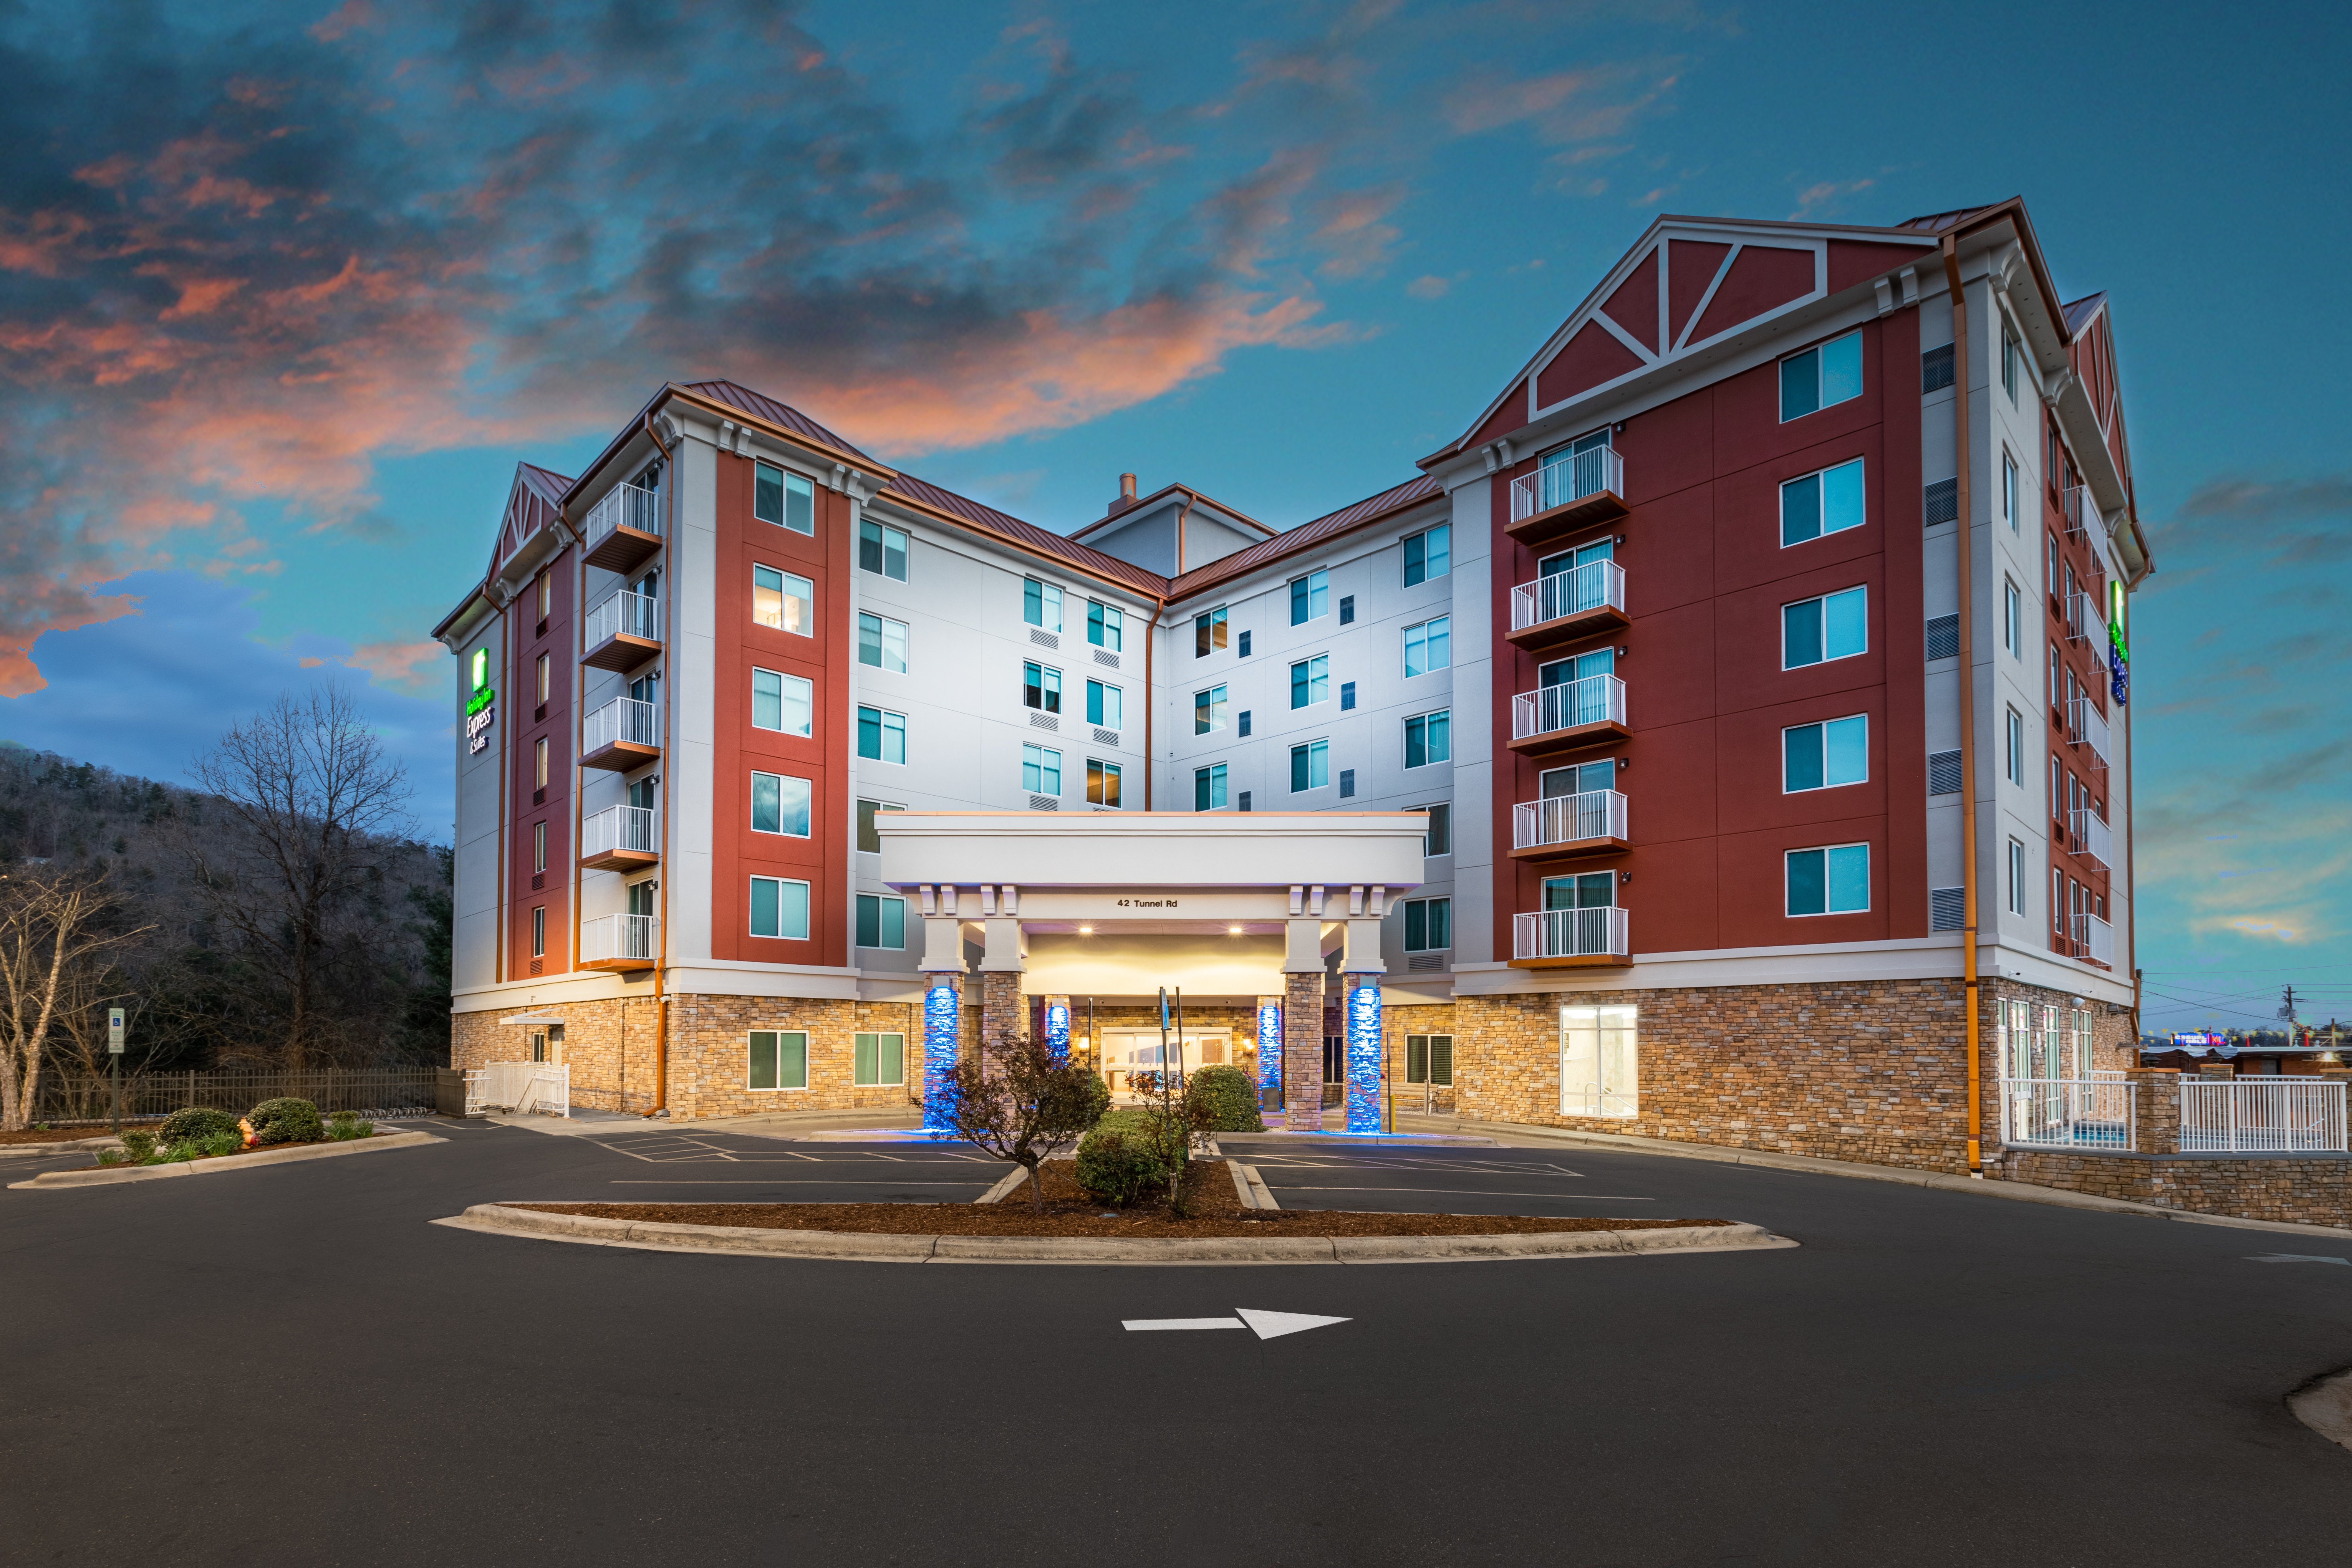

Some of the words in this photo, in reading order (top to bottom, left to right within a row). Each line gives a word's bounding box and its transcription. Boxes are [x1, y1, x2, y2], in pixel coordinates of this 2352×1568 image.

[467, 694, 483, 716] Holiday
[467, 706, 491, 739] Express
[470, 742, 474, 755] &
[473, 736, 485, 752] Suites
